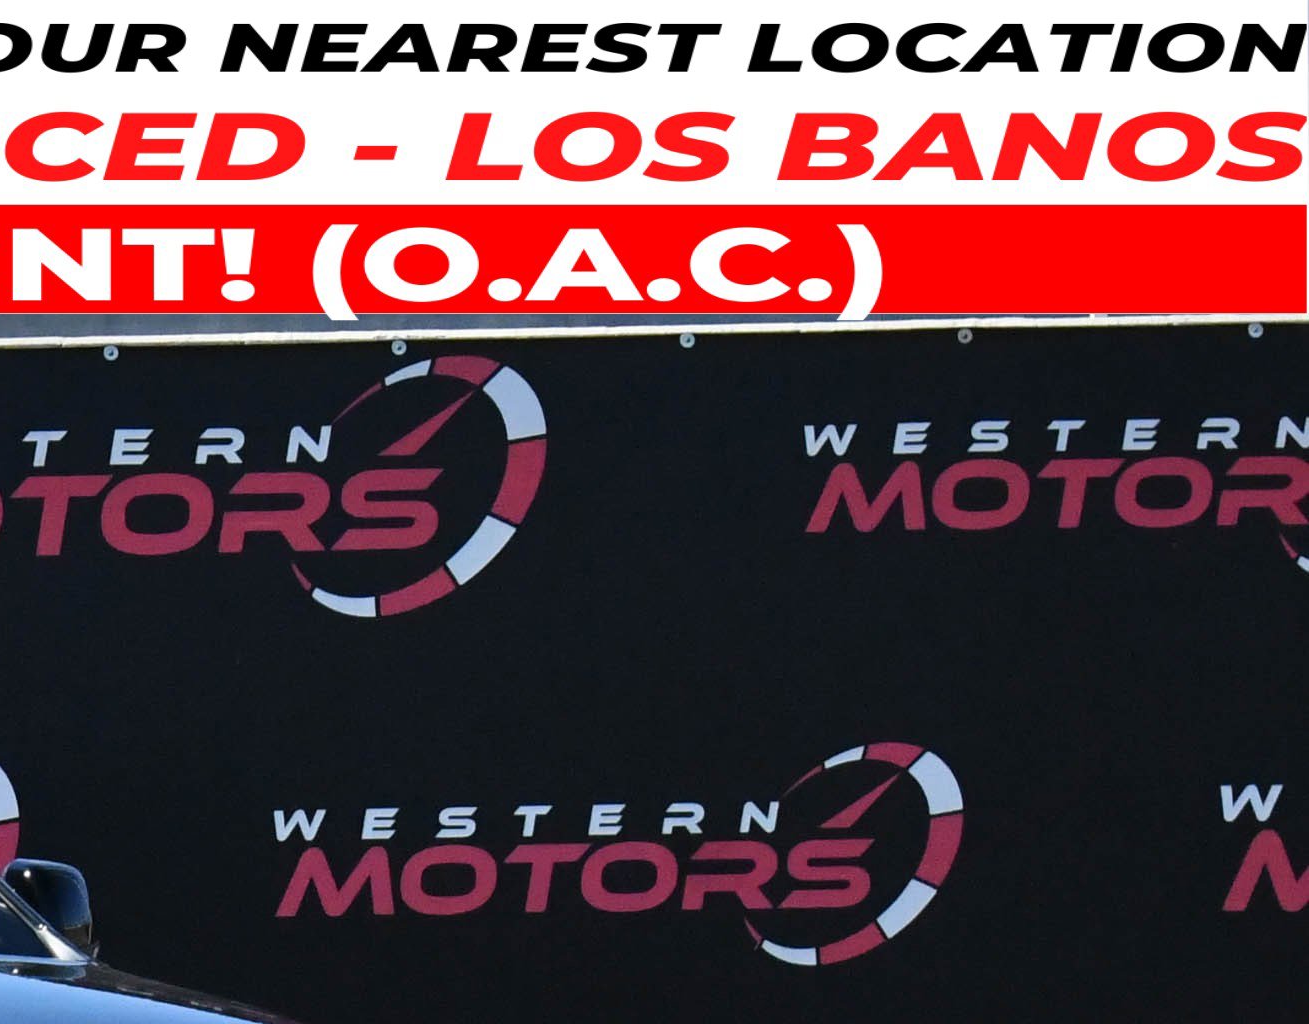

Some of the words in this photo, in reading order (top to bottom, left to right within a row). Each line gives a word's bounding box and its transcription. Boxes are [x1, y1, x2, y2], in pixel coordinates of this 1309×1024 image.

[804, 416, 1307, 457] WESTERN
[805, 456, 1307, 533] MOTOR
[273, 802, 780, 842] WESTERN
[275, 838, 875, 917] MOTORS
